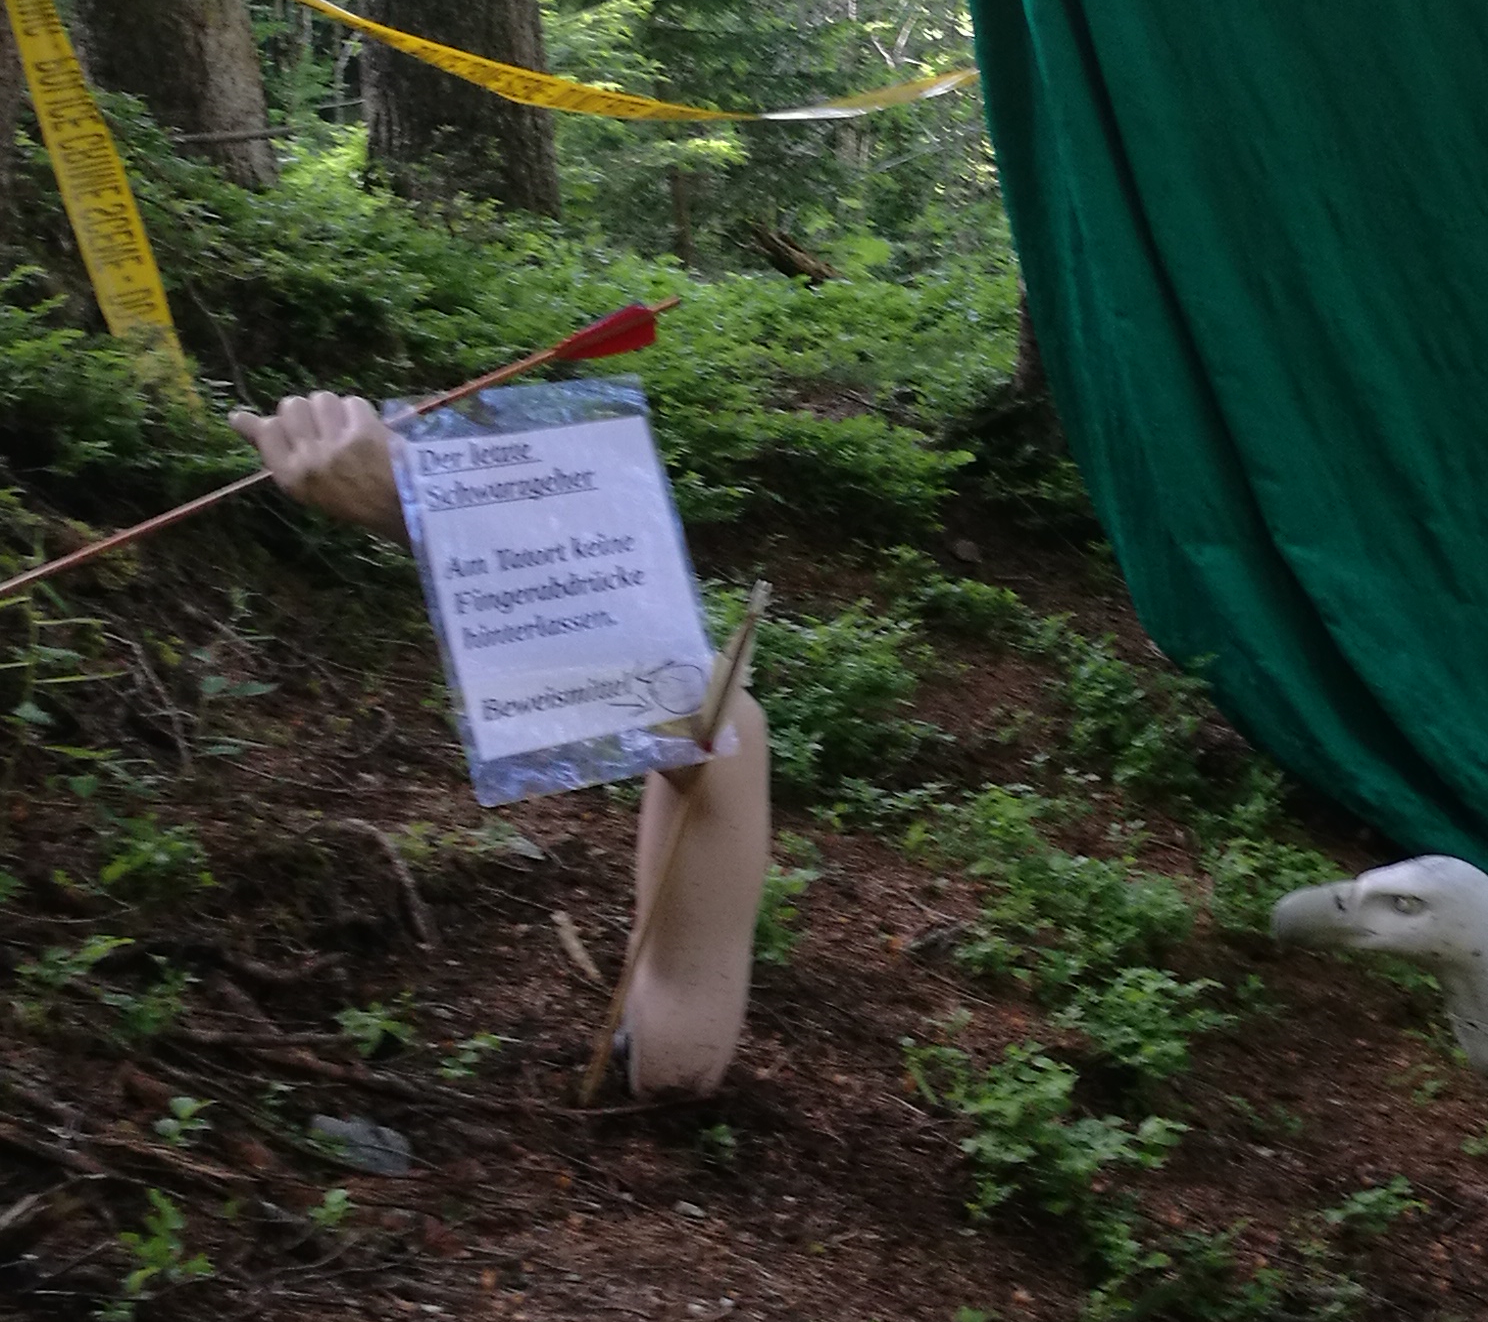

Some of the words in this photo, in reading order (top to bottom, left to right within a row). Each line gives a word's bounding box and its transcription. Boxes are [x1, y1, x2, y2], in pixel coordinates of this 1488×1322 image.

[417, 449, 463, 472] Der
[468, 441, 534, 466] letzte
[446, 557, 489, 580] Am
[494, 543, 569, 572] Tatort
[569, 533, 636, 560] keine
[454, 565, 647, 615] Fingerabdrücke
[463, 610, 620, 651] hinterlassen.
